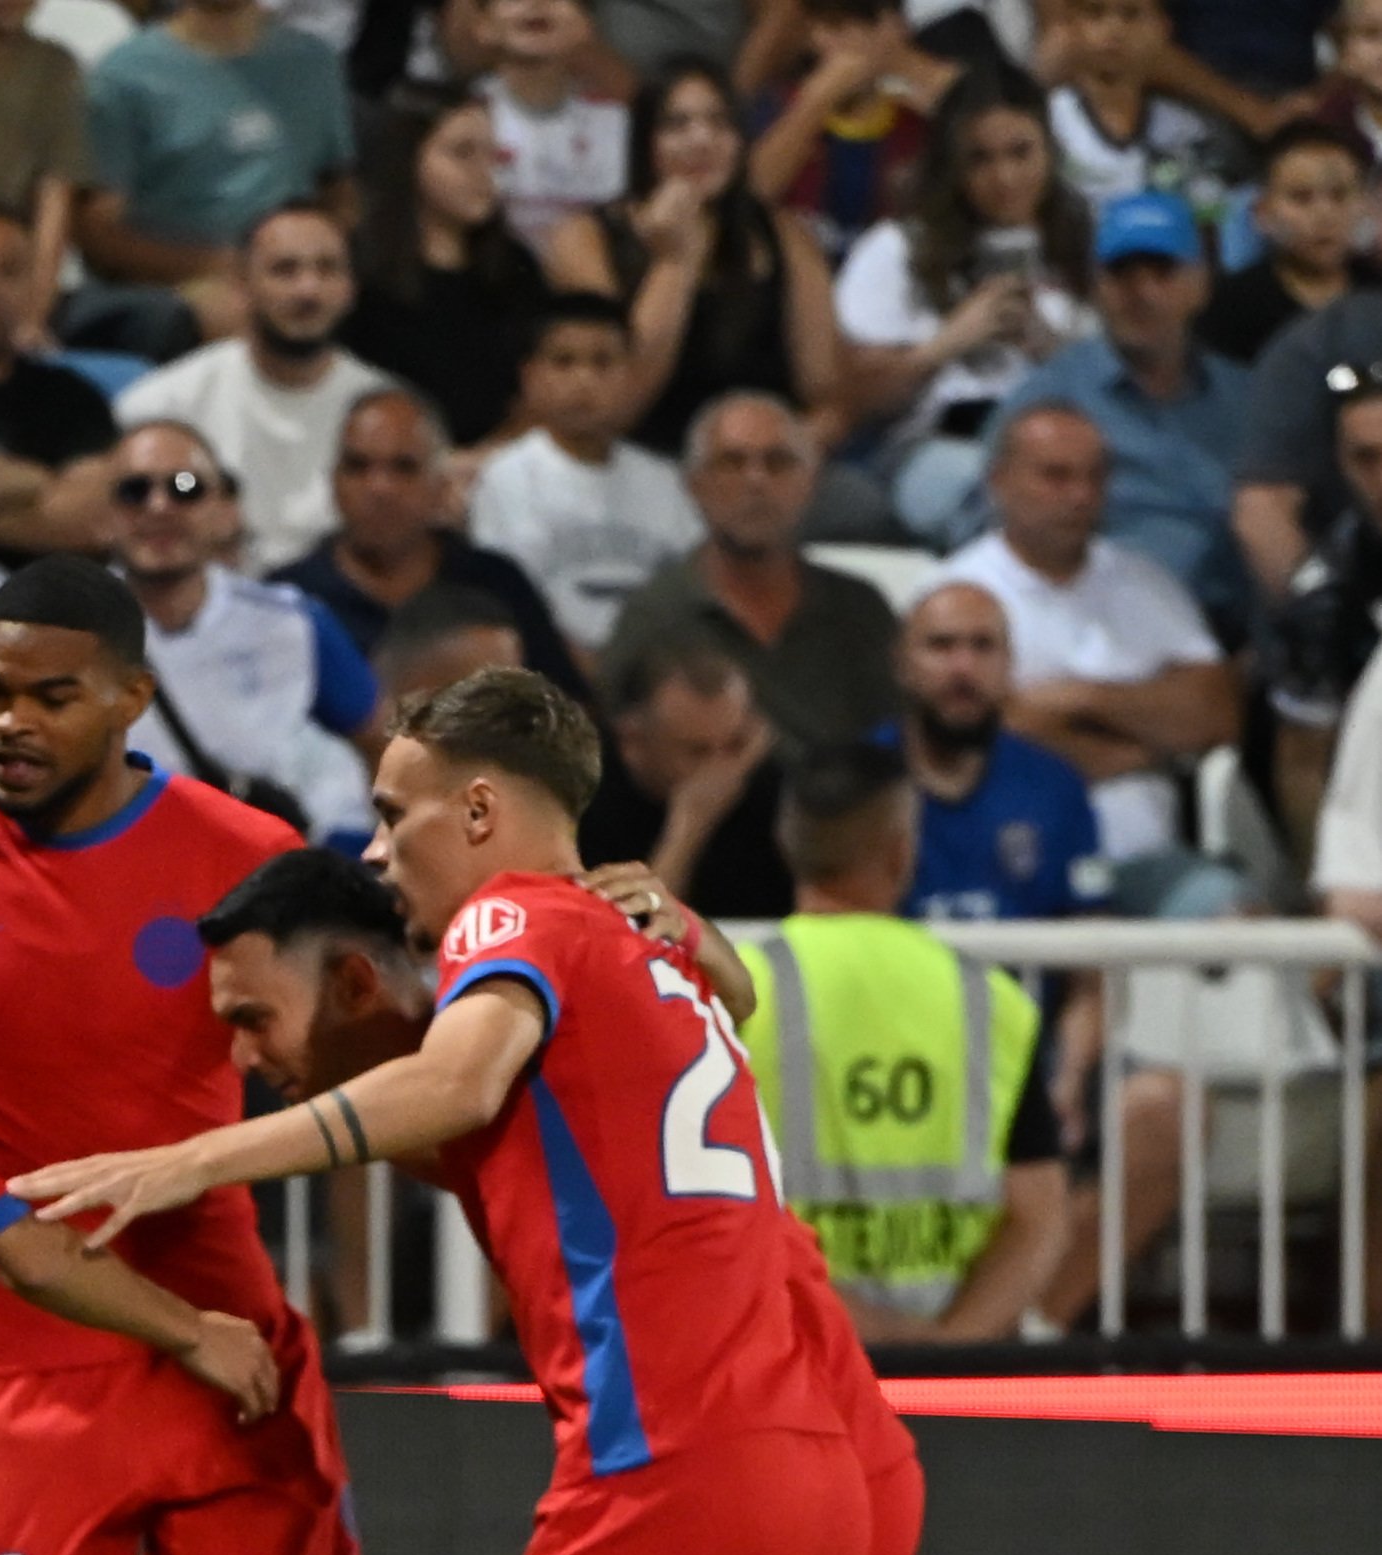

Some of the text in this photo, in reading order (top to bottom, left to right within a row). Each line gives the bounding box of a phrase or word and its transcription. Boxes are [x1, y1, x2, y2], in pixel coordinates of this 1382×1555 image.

[443, 899, 523, 955] MG
[647, 957, 783, 1210] 2
[844, 1055, 934, 1124] 60
